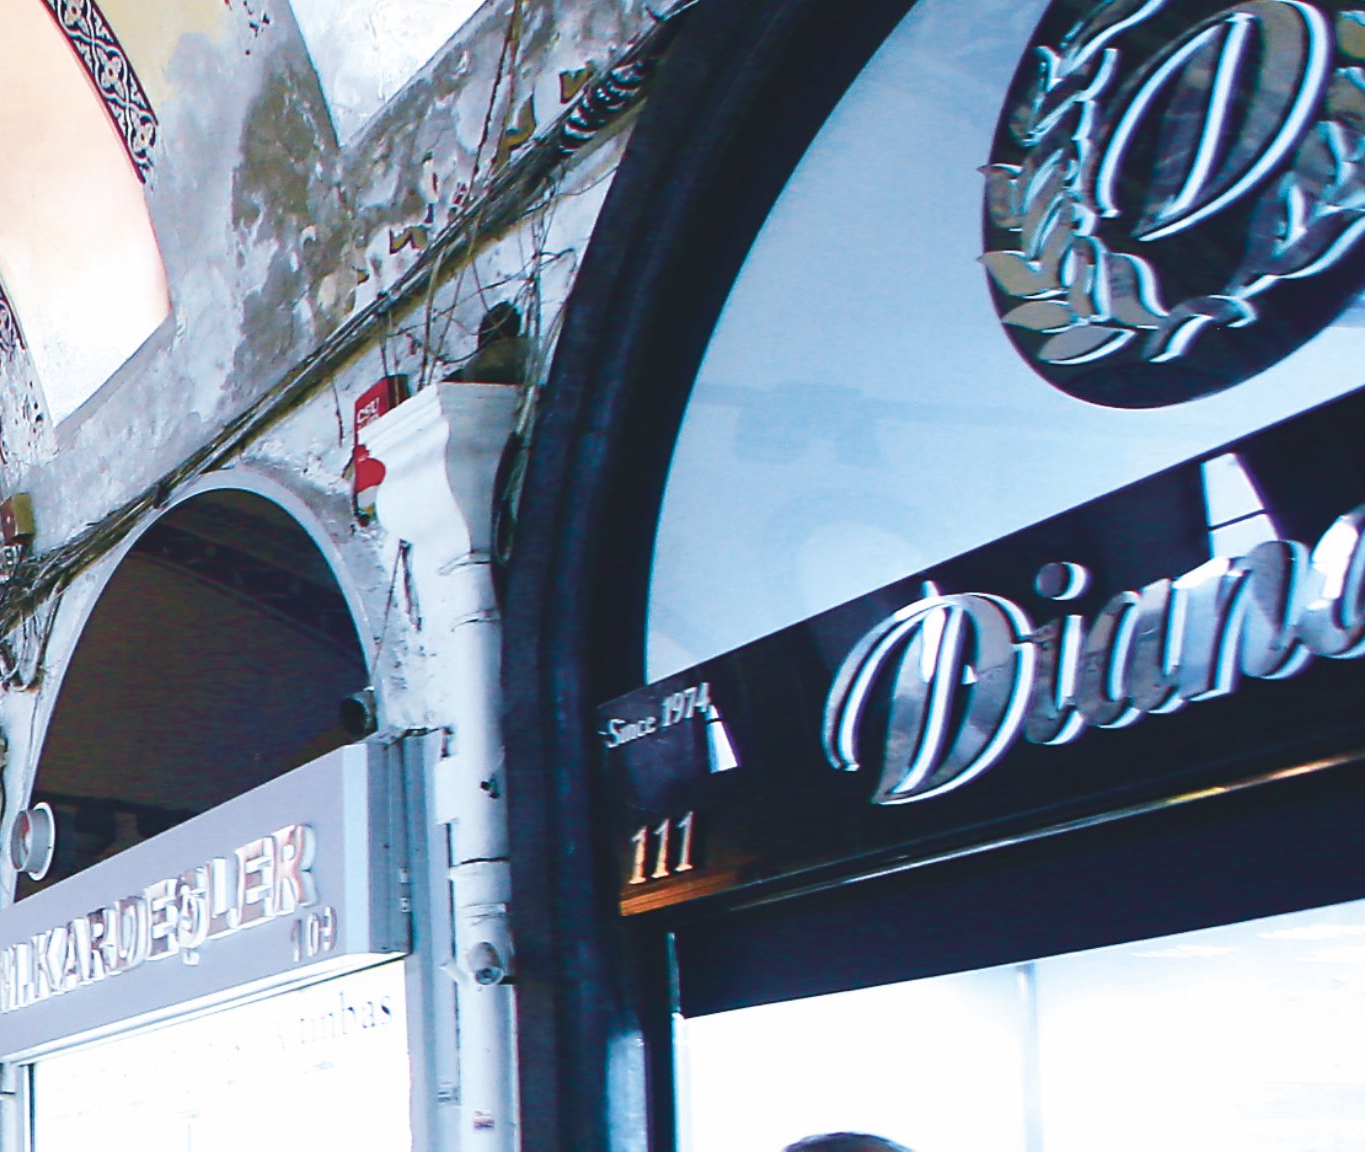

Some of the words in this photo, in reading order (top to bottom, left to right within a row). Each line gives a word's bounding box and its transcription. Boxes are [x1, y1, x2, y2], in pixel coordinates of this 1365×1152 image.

[607, 716, 657, 748] Since
[662, 682, 712, 727] 1974
[629, 810, 693, 885] 111
